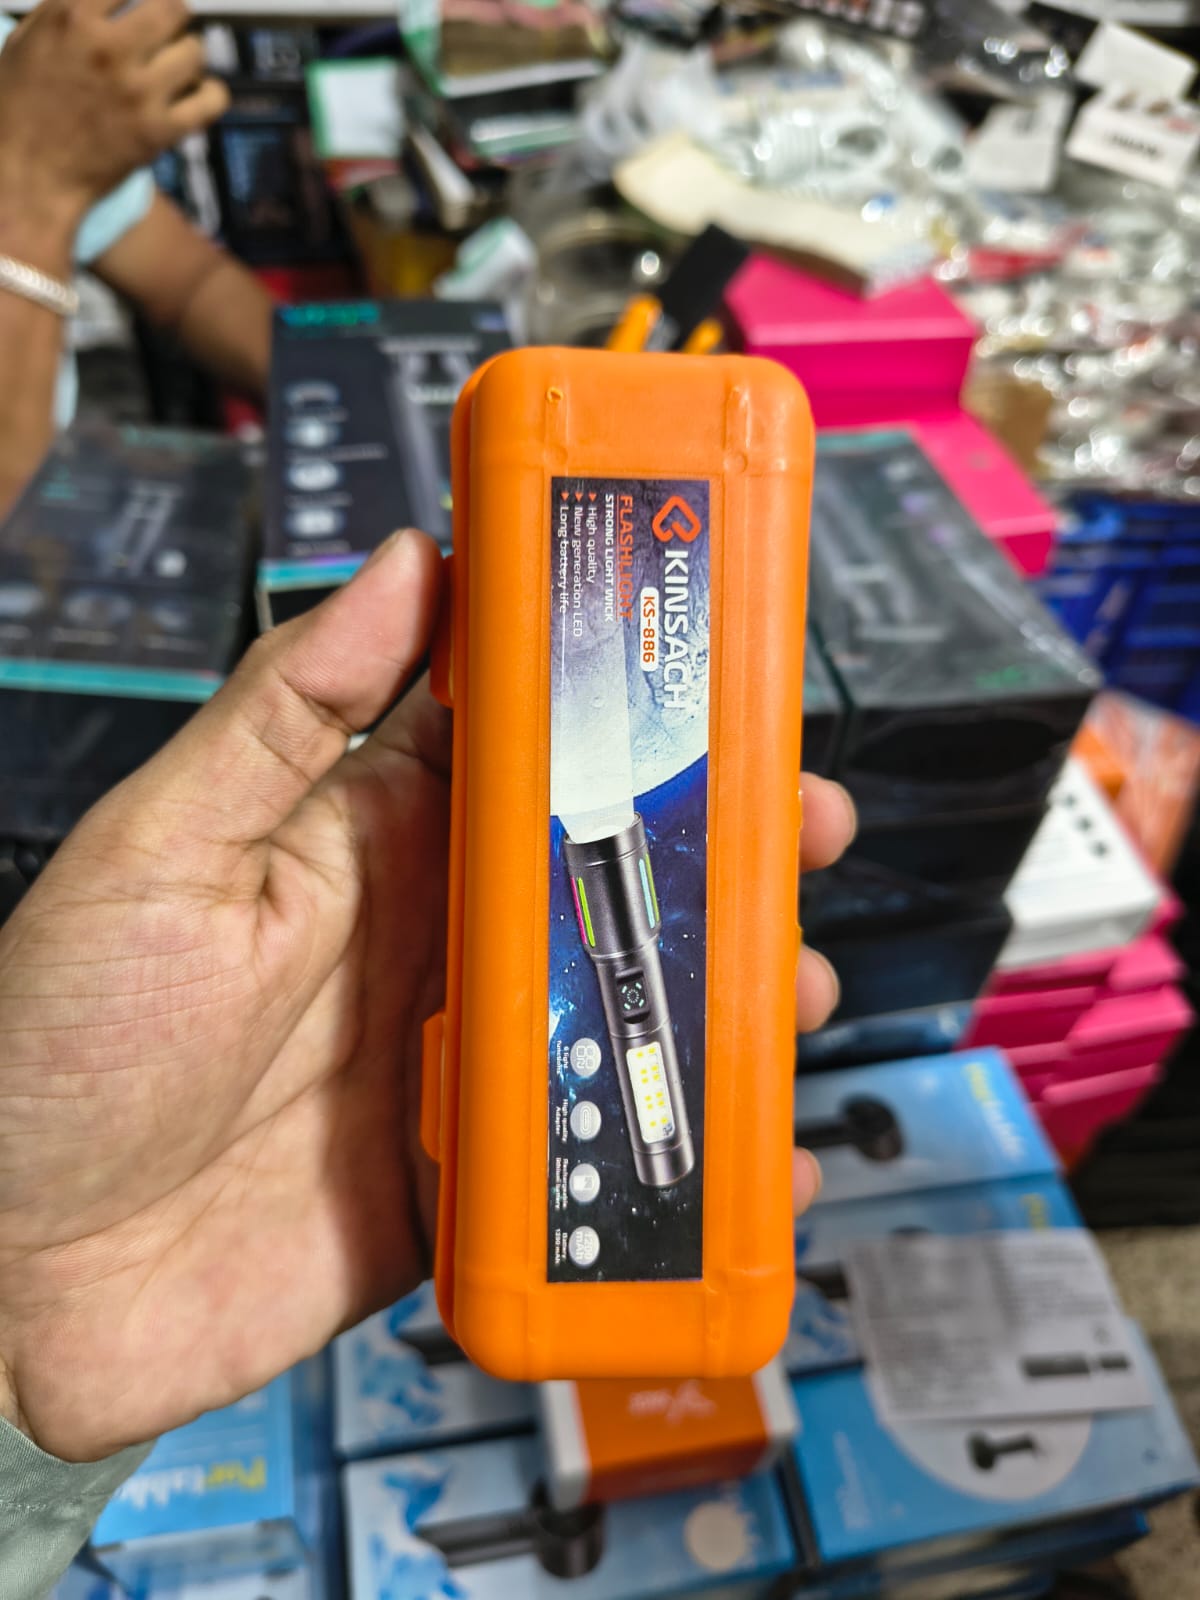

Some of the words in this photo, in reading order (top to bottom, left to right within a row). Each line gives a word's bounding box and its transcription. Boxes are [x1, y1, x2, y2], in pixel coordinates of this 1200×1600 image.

[558, 506, 569, 537] Long
[573, 506, 583, 536] New
[586, 506, 598, 535] High
[605, 493, 614, 545] STRONG
[558, 539, 569, 589] battery
[572, 539, 583, 609] generation
[586, 539, 598, 583] quality
[605, 548, 614, 586] LIGHT
[619, 495, 633, 622] FLASHLIGHT
[560, 592, 569, 614] life
[605, 589, 614, 622] WICK
[573, 612, 583, 637] LED
[642, 596, 656, 663] KS-886
[663, 550, 689, 710] KINSACH
[575, 1231, 584, 1260] mAh
